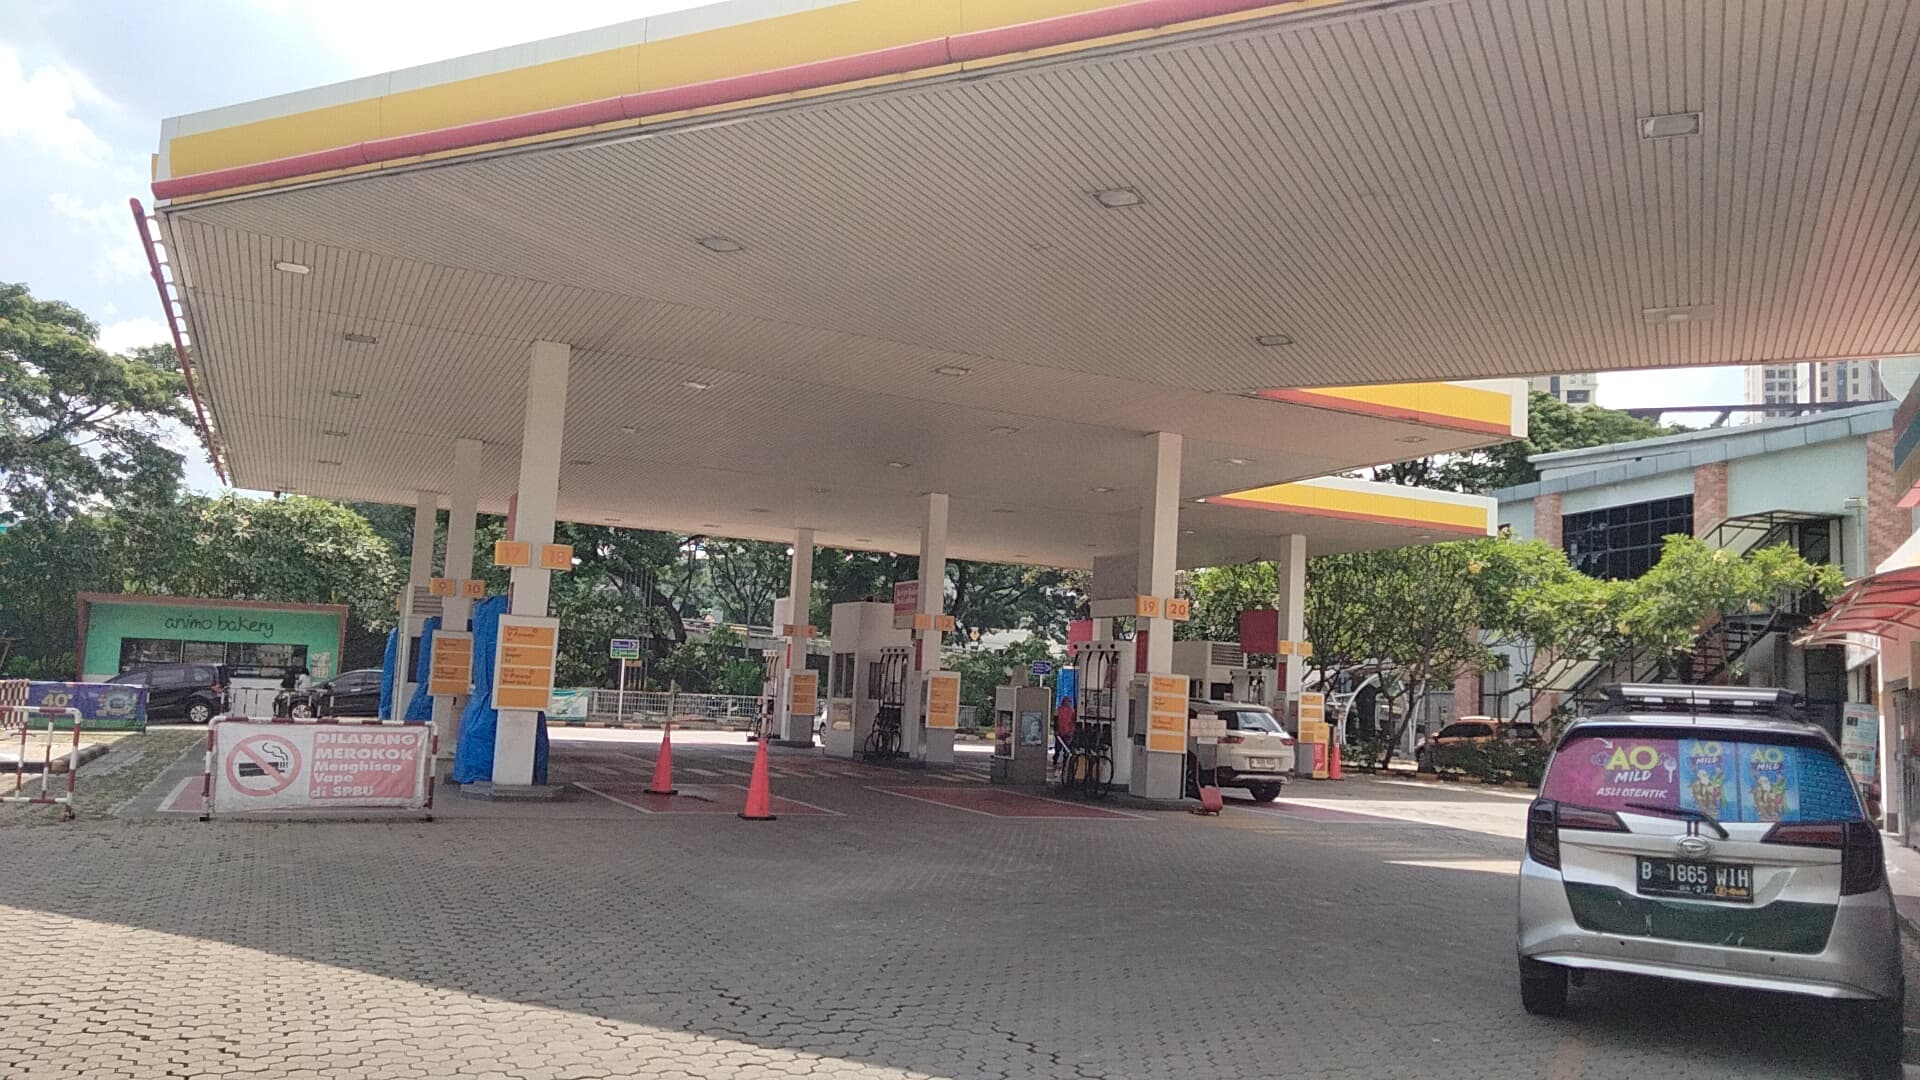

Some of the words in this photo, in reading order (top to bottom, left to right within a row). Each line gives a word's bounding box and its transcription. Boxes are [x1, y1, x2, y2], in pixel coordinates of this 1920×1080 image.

[503, 545, 521, 562] 17
[548, 549, 566, 565] 18
[467, 583, 481, 595] 10
[1143, 600, 1155, 612] 19
[1170, 603, 1186, 616] 20
[164, 613, 213, 631] animo
[217, 615, 275, 639] bakery
[316, 733, 416, 745] DILARANG
[315, 747, 414, 760] MEROKOK
[1691, 741, 1722, 757] AO
[1752, 748, 1783, 763] AO
[1606, 745, 1659, 771] AO
[1695, 757, 1719, 765] MILD
[315, 761, 402, 774] Menghisap
[1757, 763, 1780, 771] MILD
[314, 772, 354, 785] Vape
[1614, 770, 1652, 784] MILD
[310, 786, 327, 797] di
[333, 786, 374, 797] SPBU
[1596, 787, 1621, 796] ASLI
[1622, 788, 1669, 799] OTENTIK
[1641, 861, 1653, 880] B
[1666, 863, 1708, 884] 1865
[1716, 867, 1749, 887] WIH
